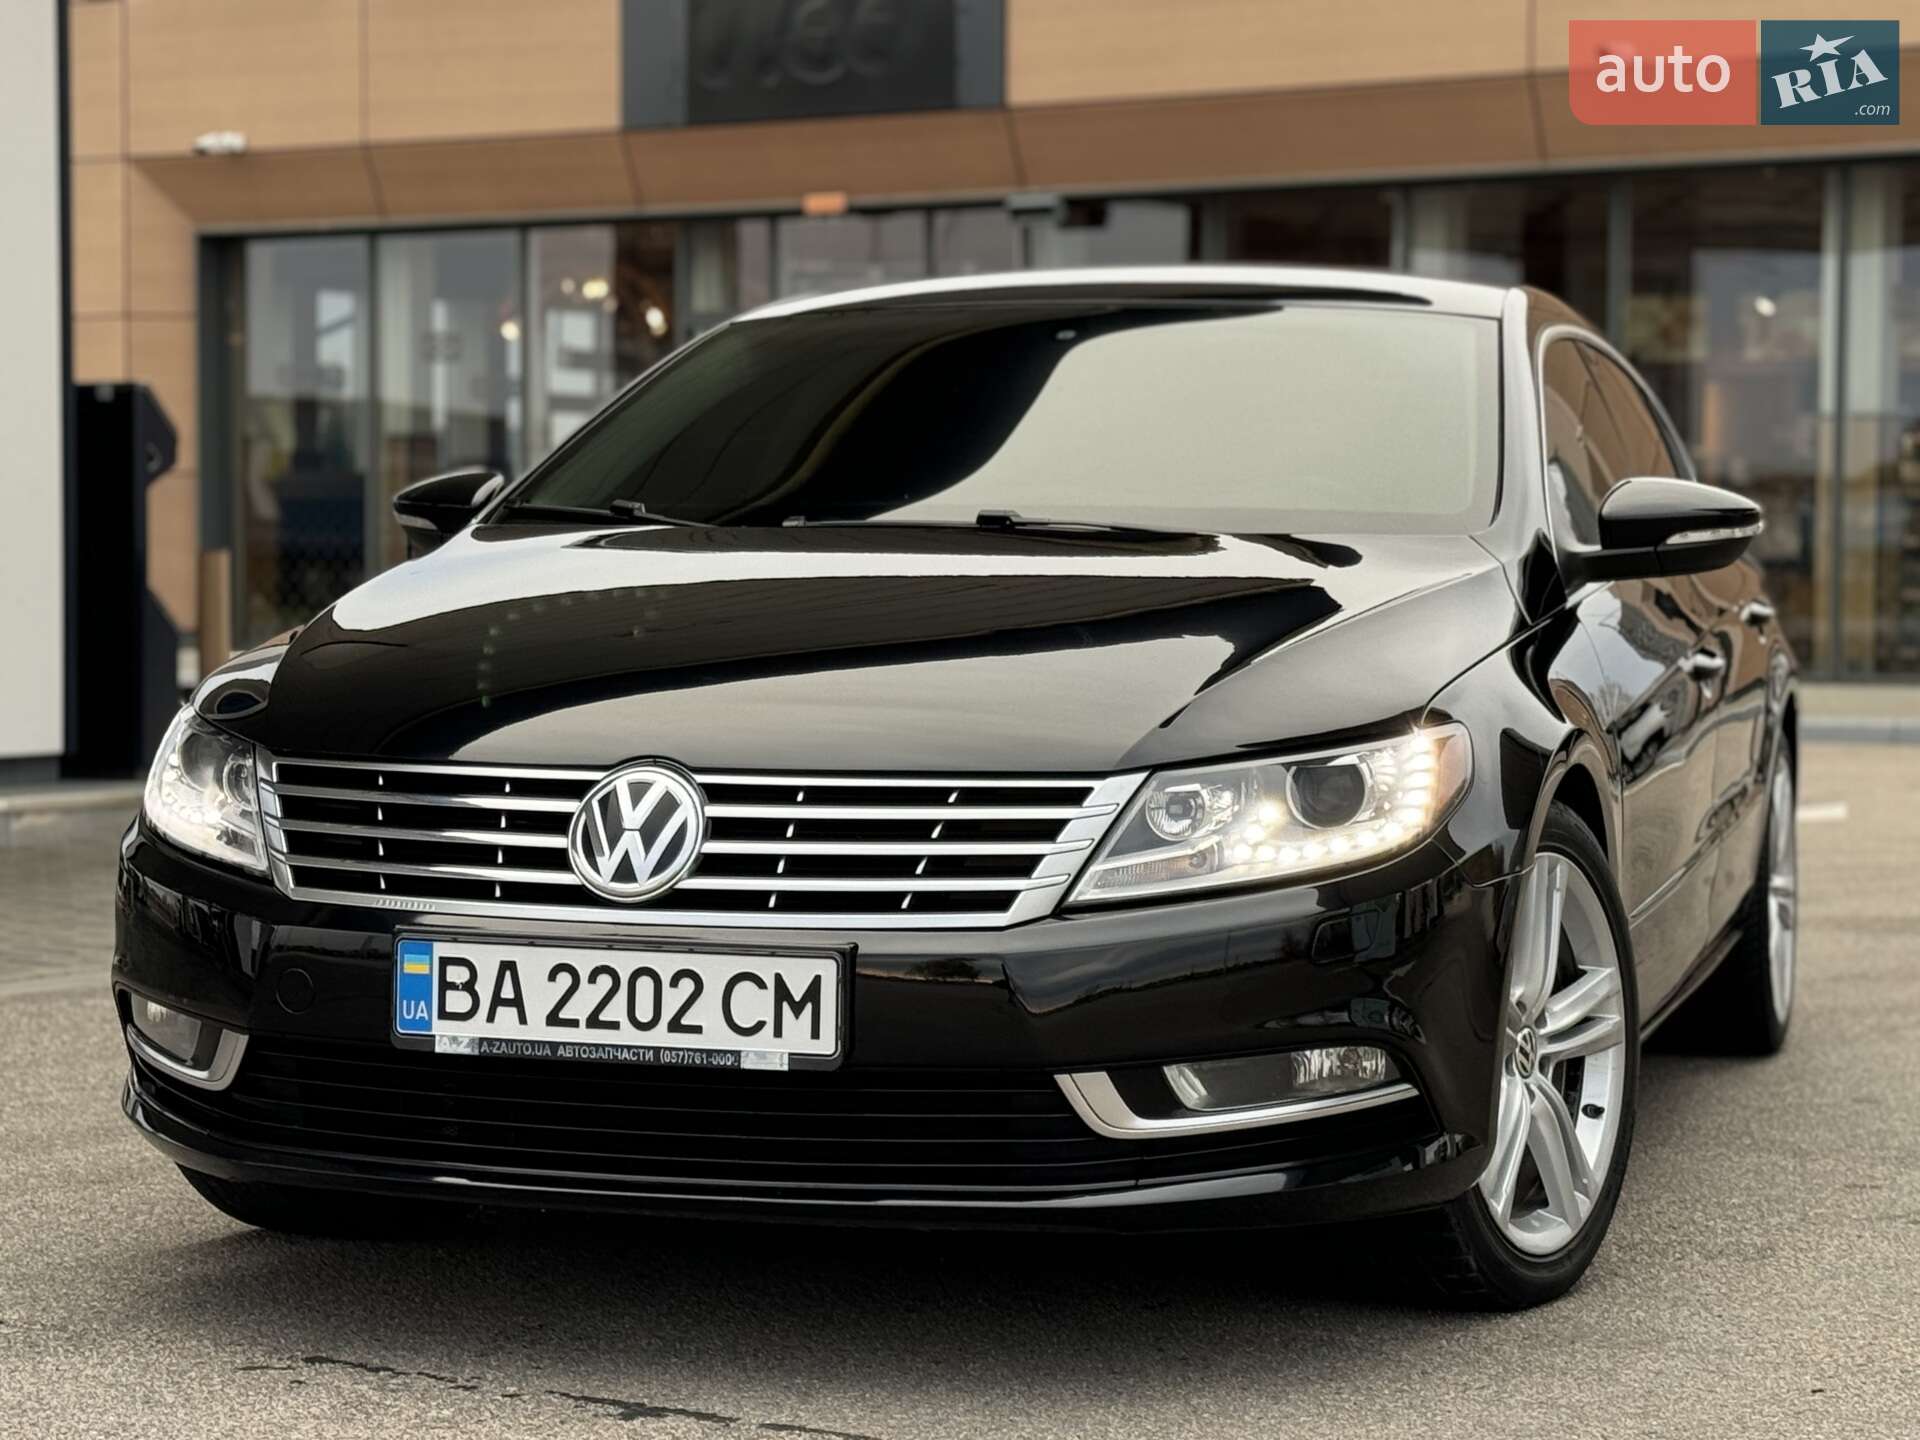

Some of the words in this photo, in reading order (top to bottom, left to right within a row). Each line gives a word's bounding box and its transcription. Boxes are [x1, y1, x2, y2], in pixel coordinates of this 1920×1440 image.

[438, 956, 528, 1025] BA
[545, 962, 704, 1034] 2202
[721, 971, 822, 1040] CM
[403, 1000, 429, 1020] UA
[557, 1045, 654, 1062] АВТОЗАПЧАСТИ
